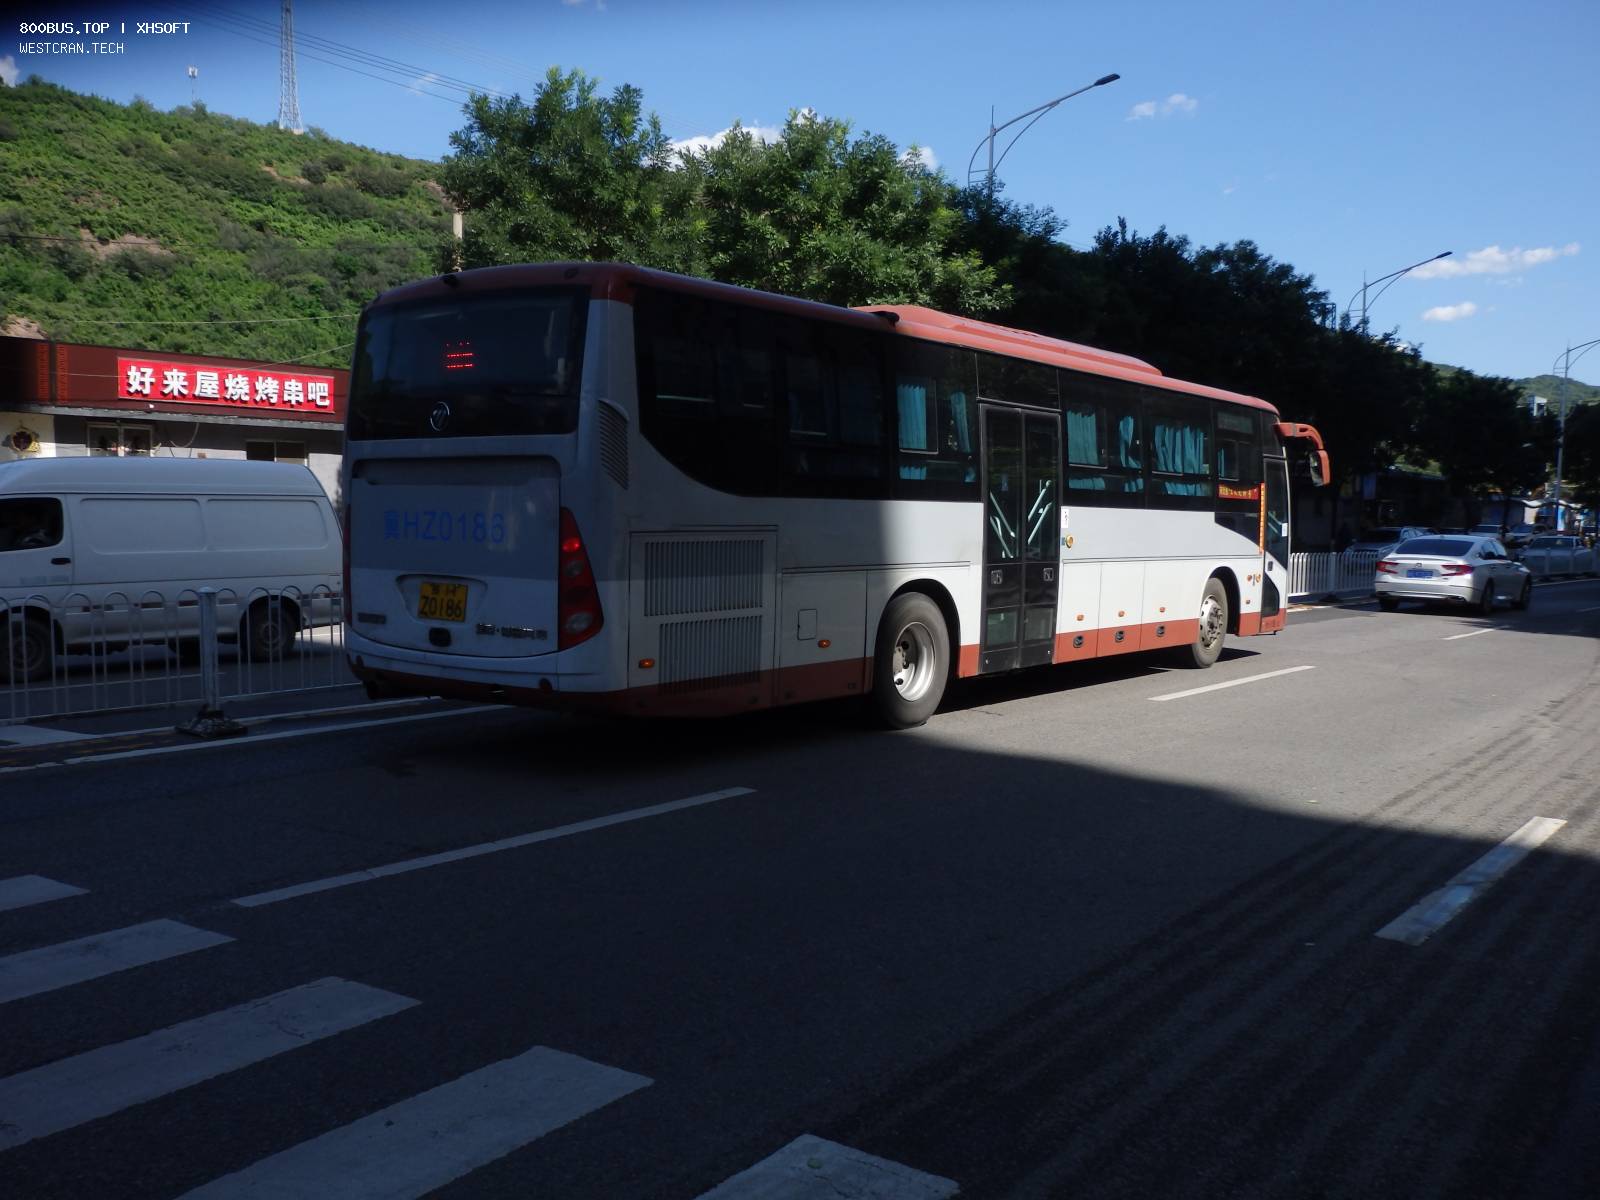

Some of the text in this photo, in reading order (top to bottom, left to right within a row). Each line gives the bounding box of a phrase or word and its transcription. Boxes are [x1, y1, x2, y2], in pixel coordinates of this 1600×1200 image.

[126, 364, 330, 407] 好来屋烧烤串吧
[419, 595, 463, 618] Z0186
